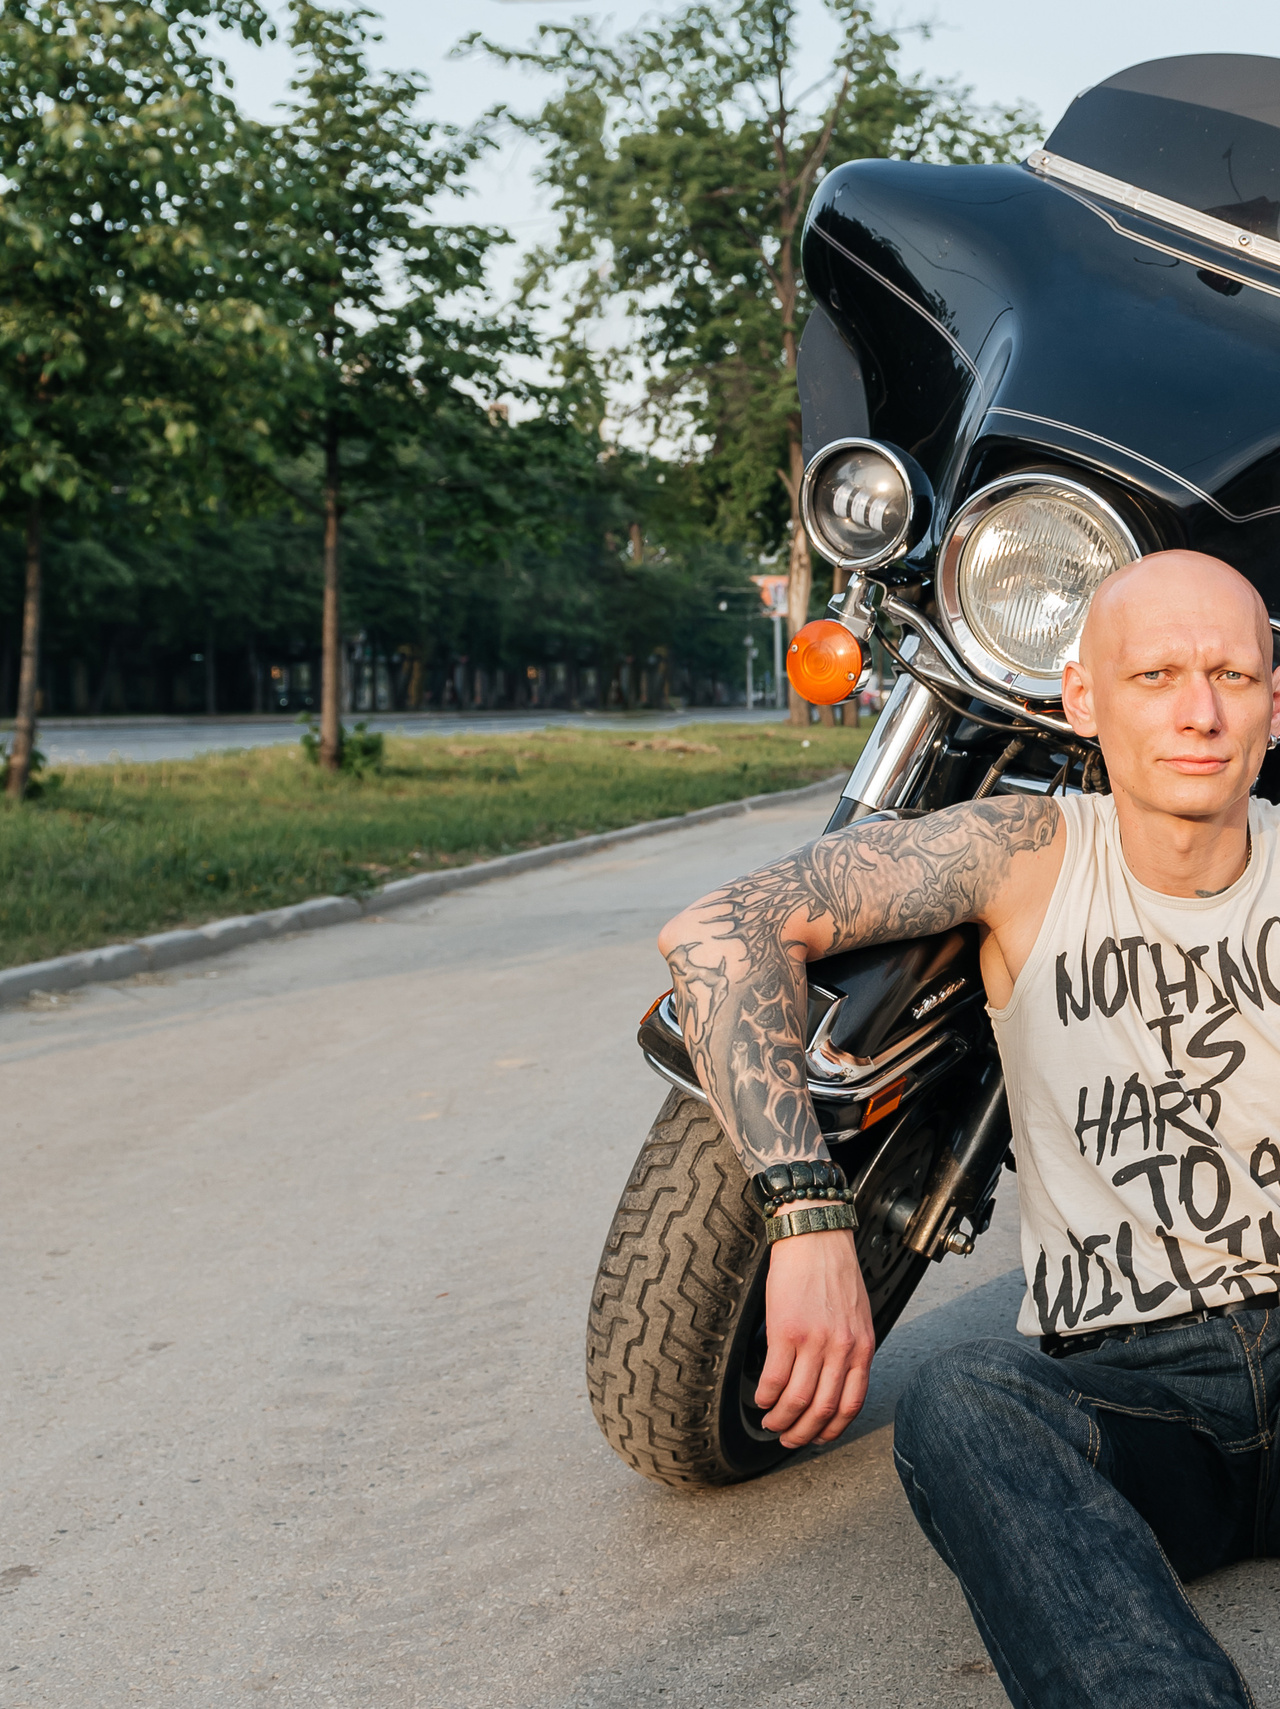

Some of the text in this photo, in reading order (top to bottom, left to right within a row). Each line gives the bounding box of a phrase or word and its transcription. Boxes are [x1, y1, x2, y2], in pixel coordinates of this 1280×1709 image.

[1148, 1007, 1247, 1091] IS
[1074, 1071, 1224, 1166] HARD
[1111, 1144, 1232, 1232] TO
